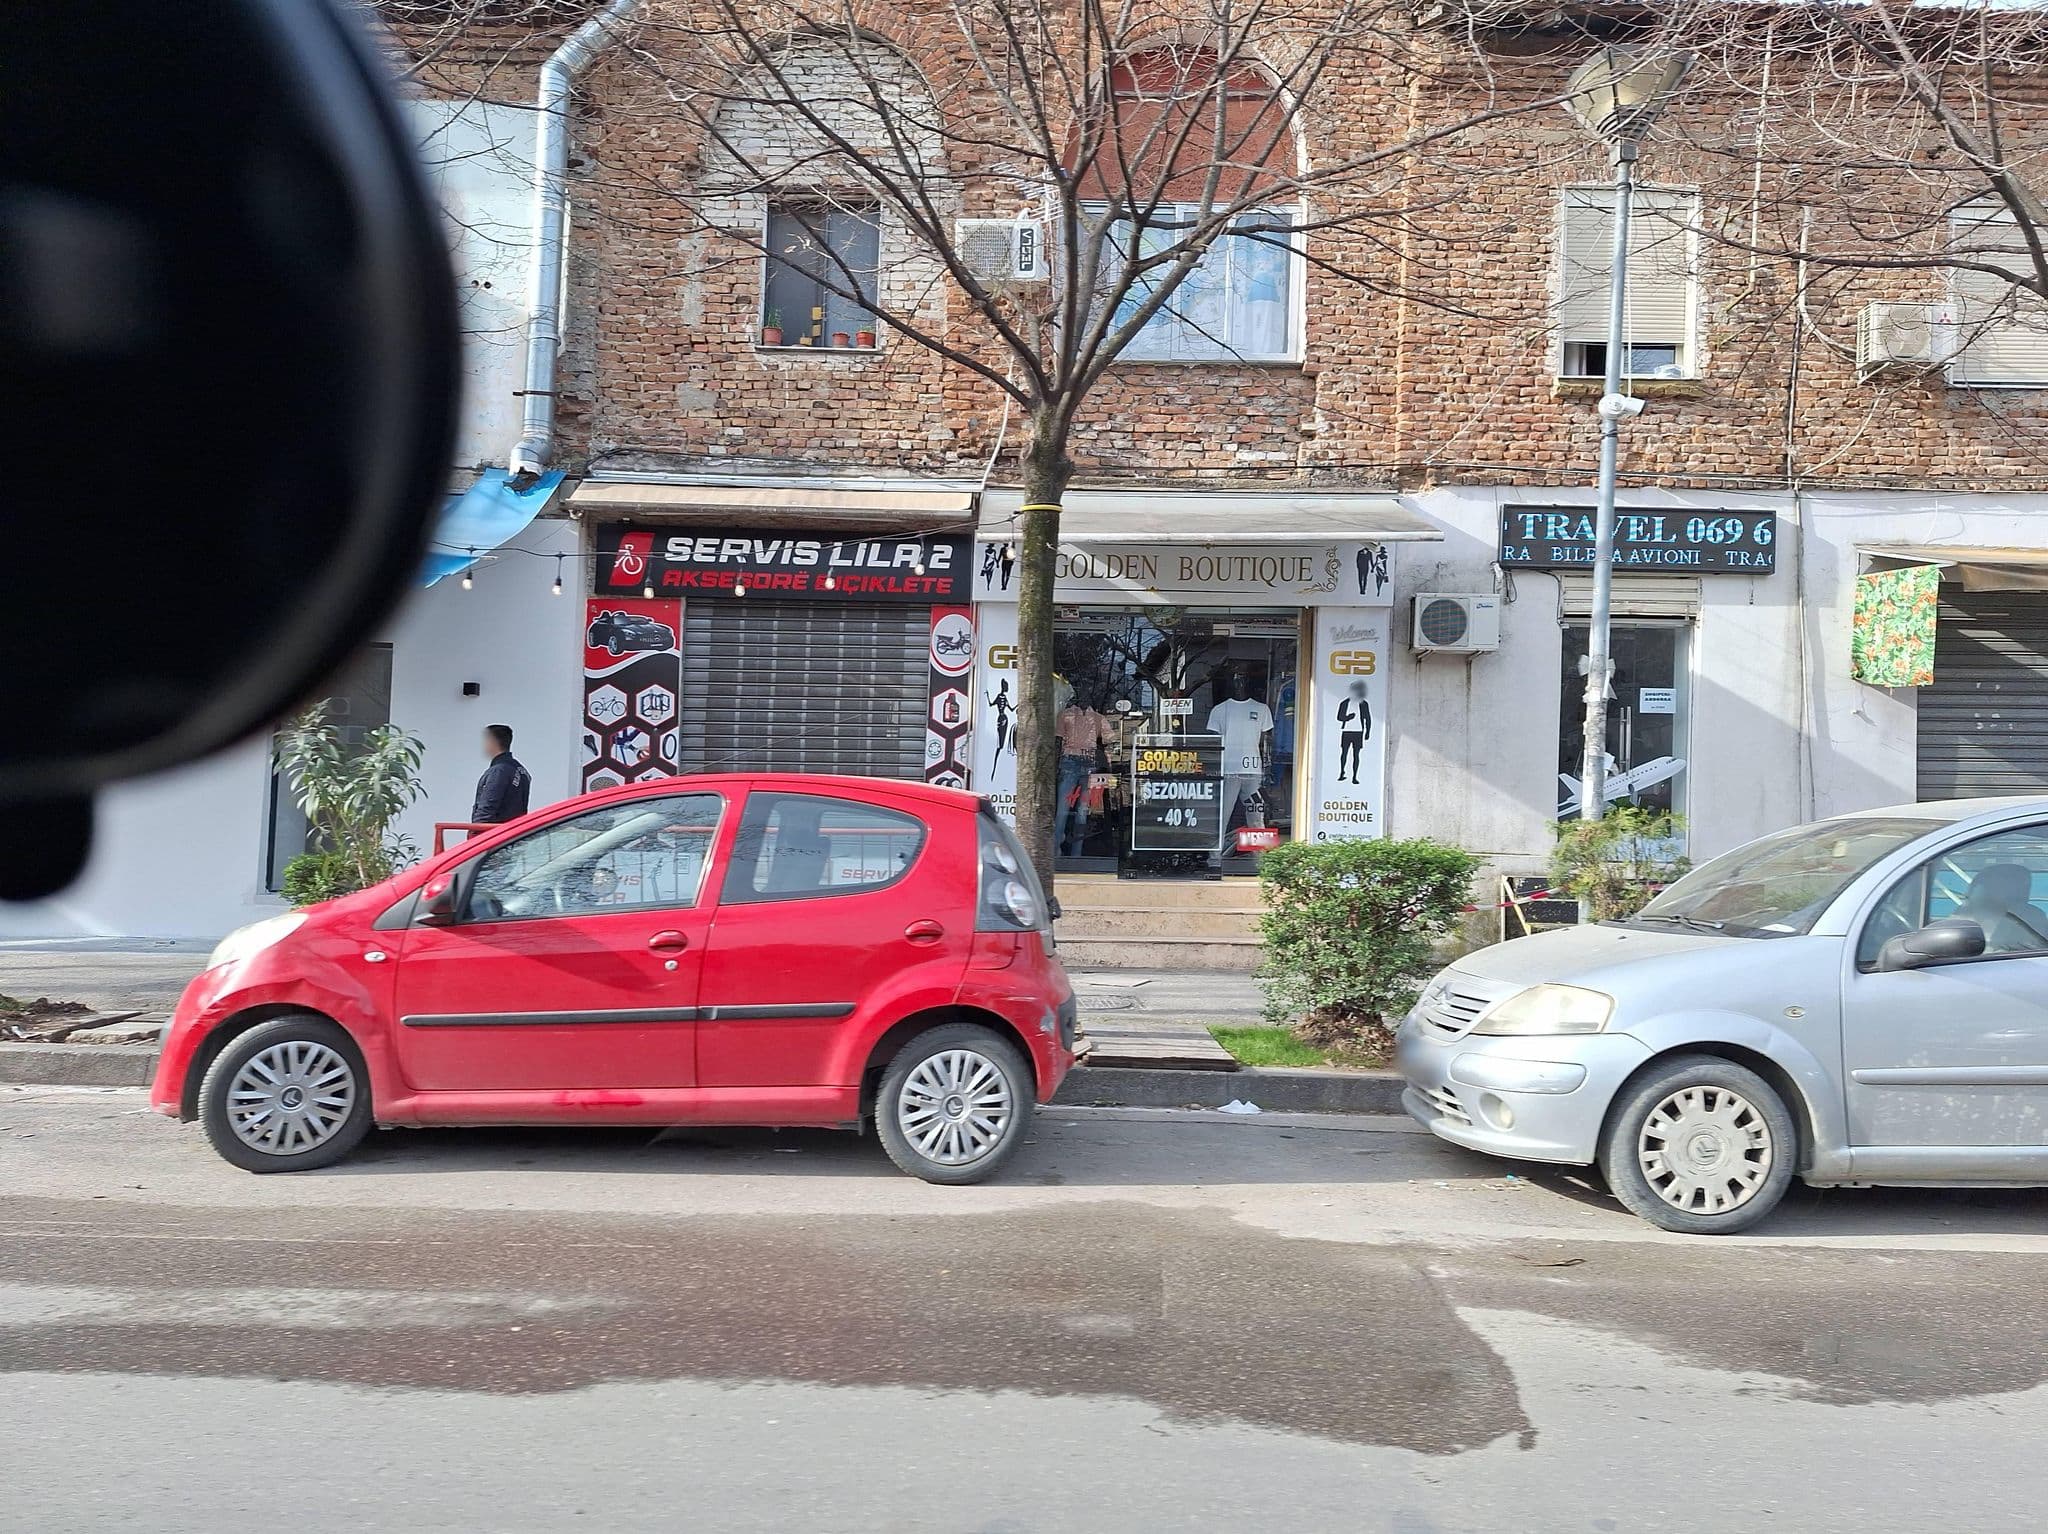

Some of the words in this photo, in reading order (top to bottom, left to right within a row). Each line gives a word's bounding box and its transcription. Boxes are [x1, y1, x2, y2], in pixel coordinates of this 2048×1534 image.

[1686, 517, 1744, 544] 069
[1753, 519, 1773, 545] 6
[664, 537, 822, 565] SERVIS
[828, 542, 922, 568] LILA
[928, 544, 954, 569] 2
[1503, 546, 1532, 560] RA
[1551, 547, 1624, 562] BILEA
[1627, 548, 1701, 564] AVIONI
[1053, 553, 1159, 580] GOLDEN
[1178, 556, 1313, 588] BOUTIQUE
[663, 569, 810, 591] AKSESORË
[1329, 650, 1376, 675] GB
[1163, 699, 1191, 708] OPEN
[1143, 751, 1198, 763] GOLDEN
[1143, 782, 1214, 800] SEZONALE
[1323, 801, 1368, 811] GOLDEN
[1318, 812, 1374, 824] BOUTIQUE
